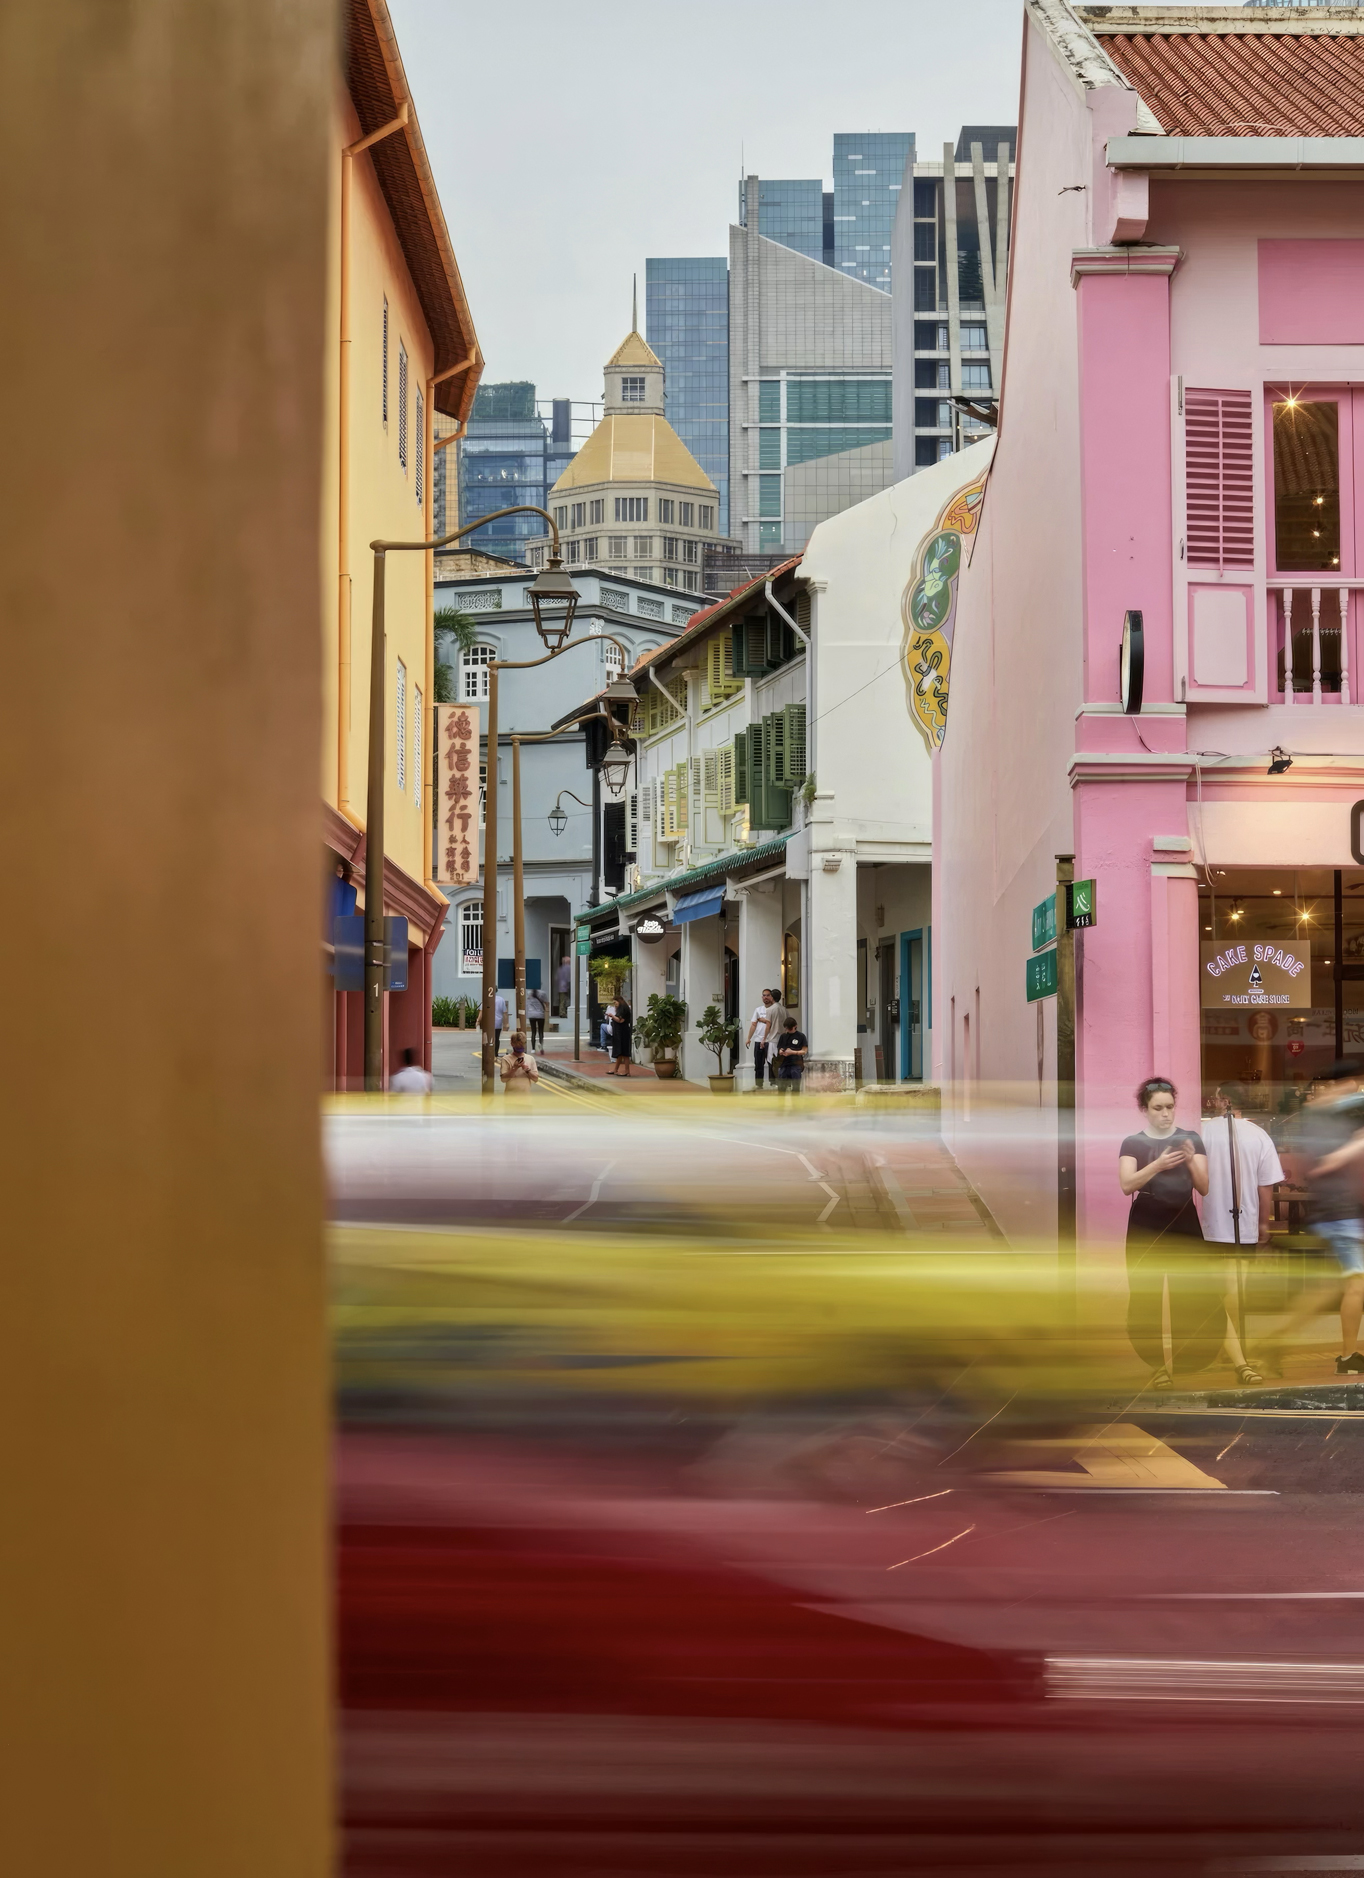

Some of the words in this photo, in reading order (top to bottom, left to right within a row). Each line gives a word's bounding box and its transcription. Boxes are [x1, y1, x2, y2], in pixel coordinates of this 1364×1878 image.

[1206, 945, 1248, 977] CAKE
[1253, 944, 1305, 978] SPADE
[373, 983, 380, 998] 1
[487, 986, 494, 998] 2
[519, 987, 525, 996] 3
